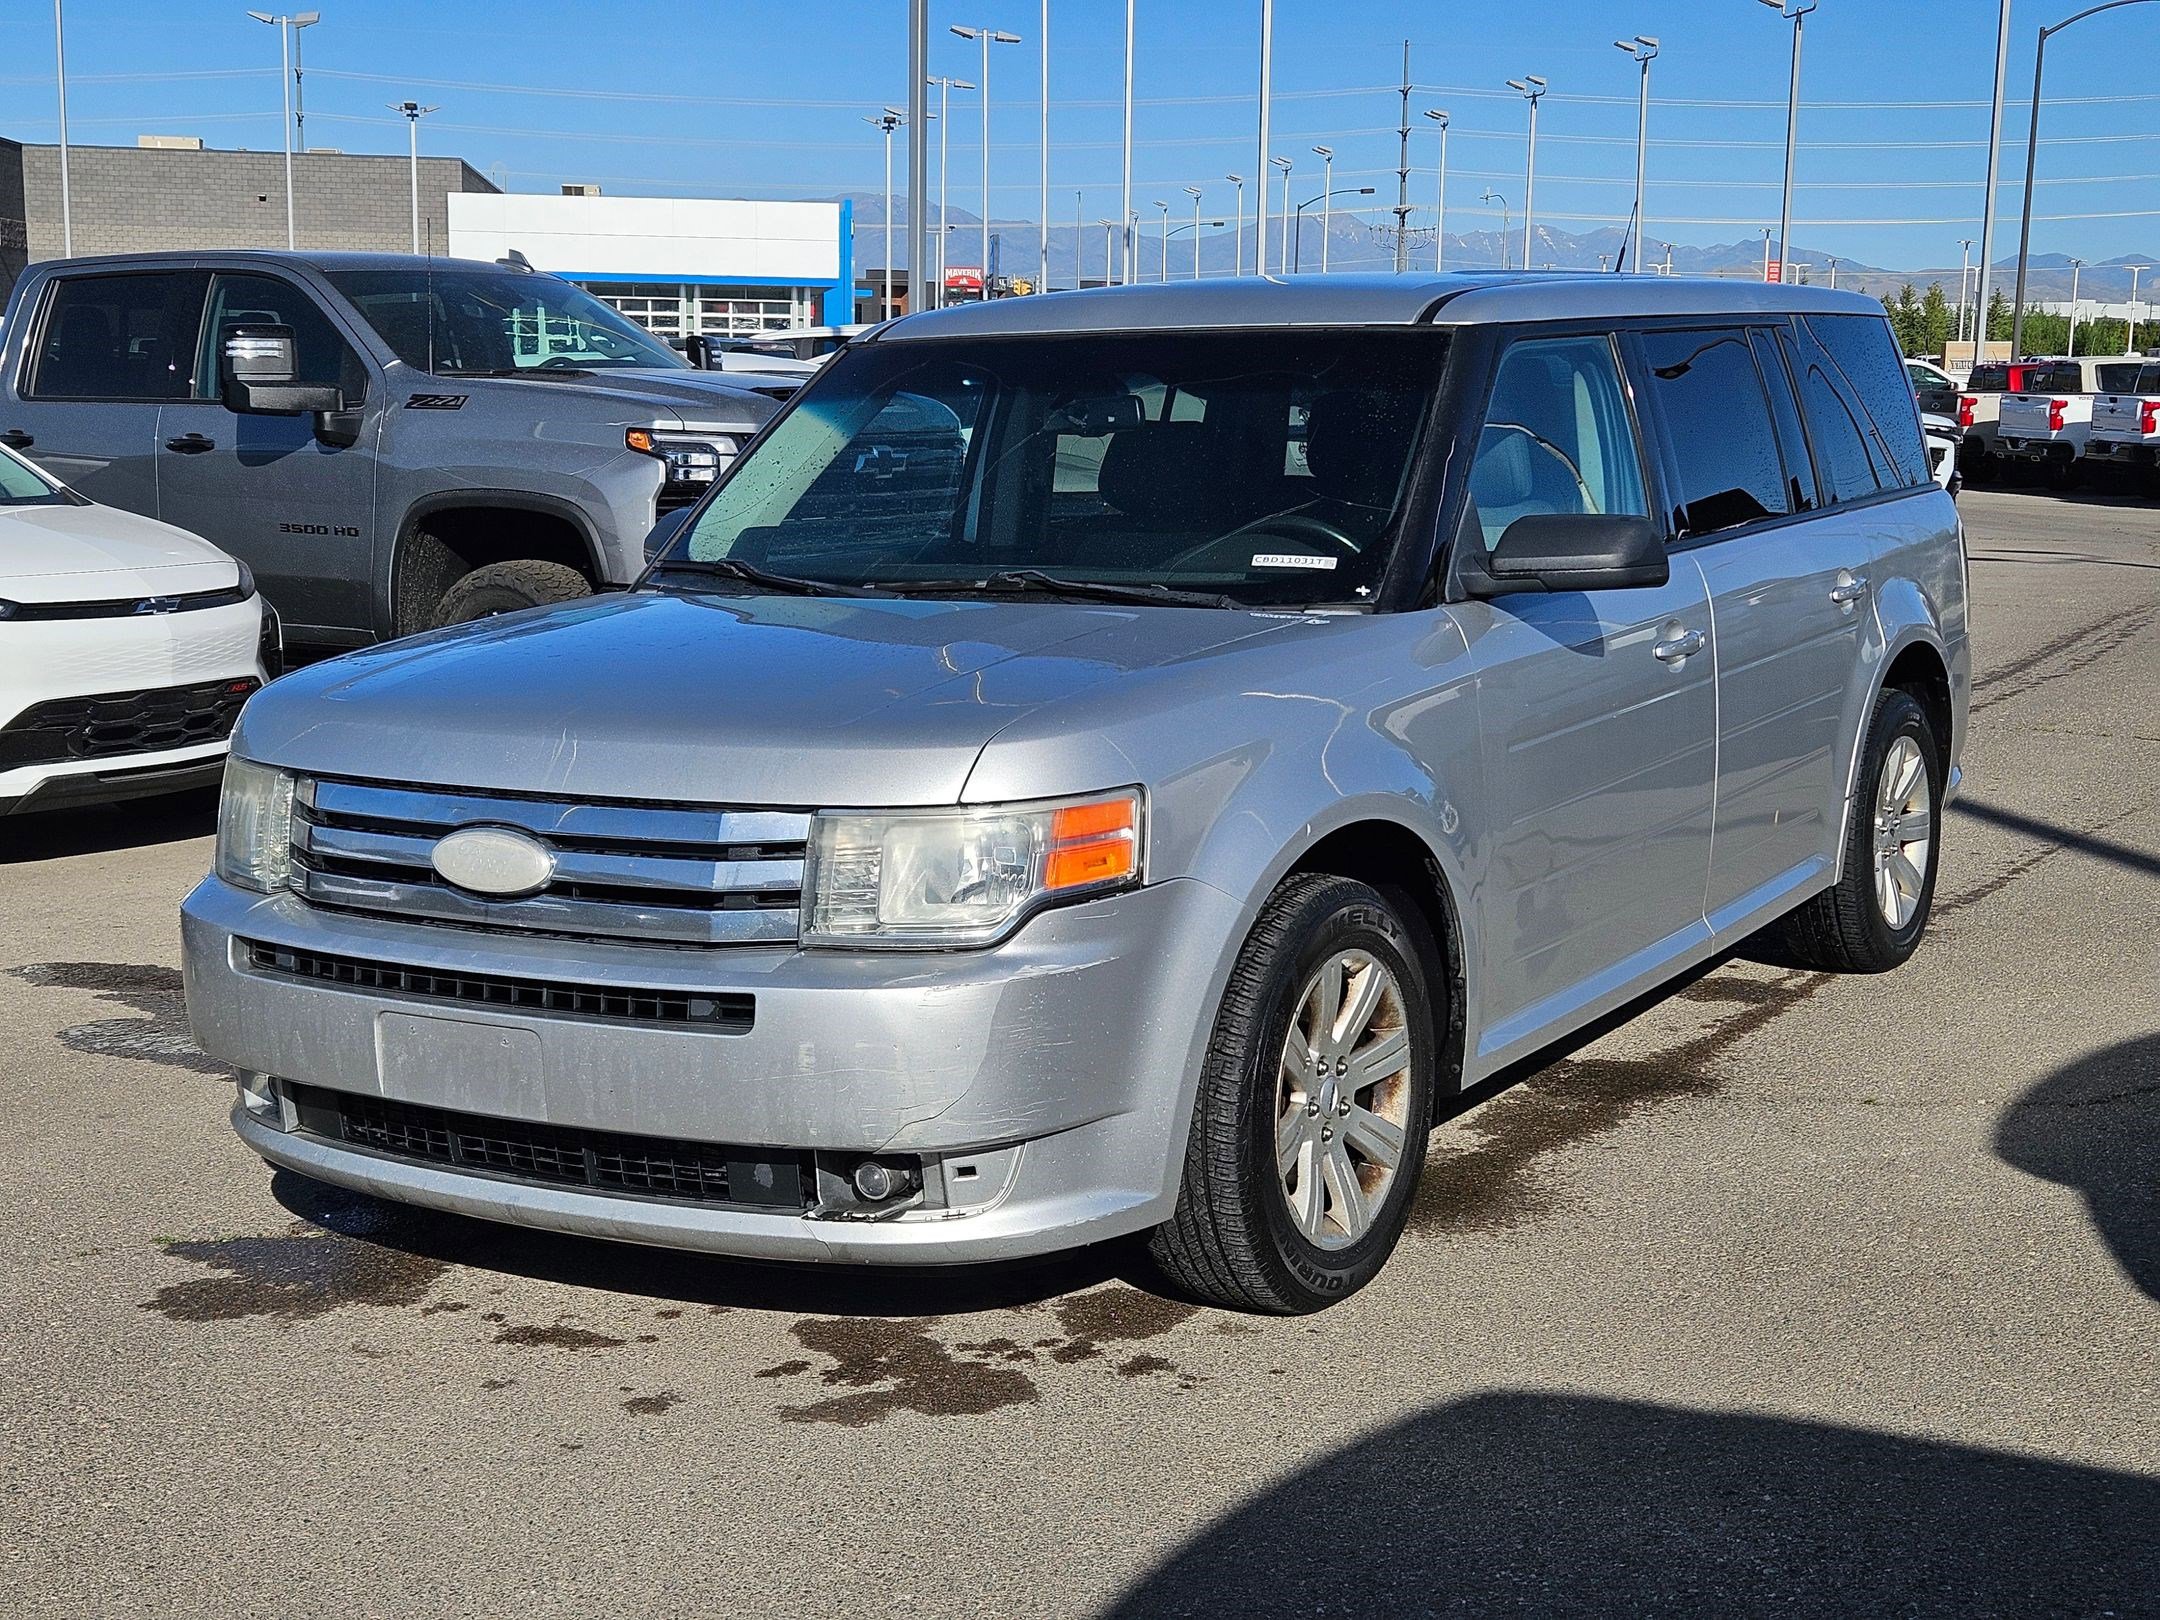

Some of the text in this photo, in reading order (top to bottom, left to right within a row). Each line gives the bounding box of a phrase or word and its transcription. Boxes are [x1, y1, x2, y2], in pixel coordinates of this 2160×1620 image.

[945, 268, 982, 281] MAVERIK
[404, 393, 470, 410] Z71
[279, 523, 360, 537] 3500 HD
[1332, 907, 1403, 940] KELLY
